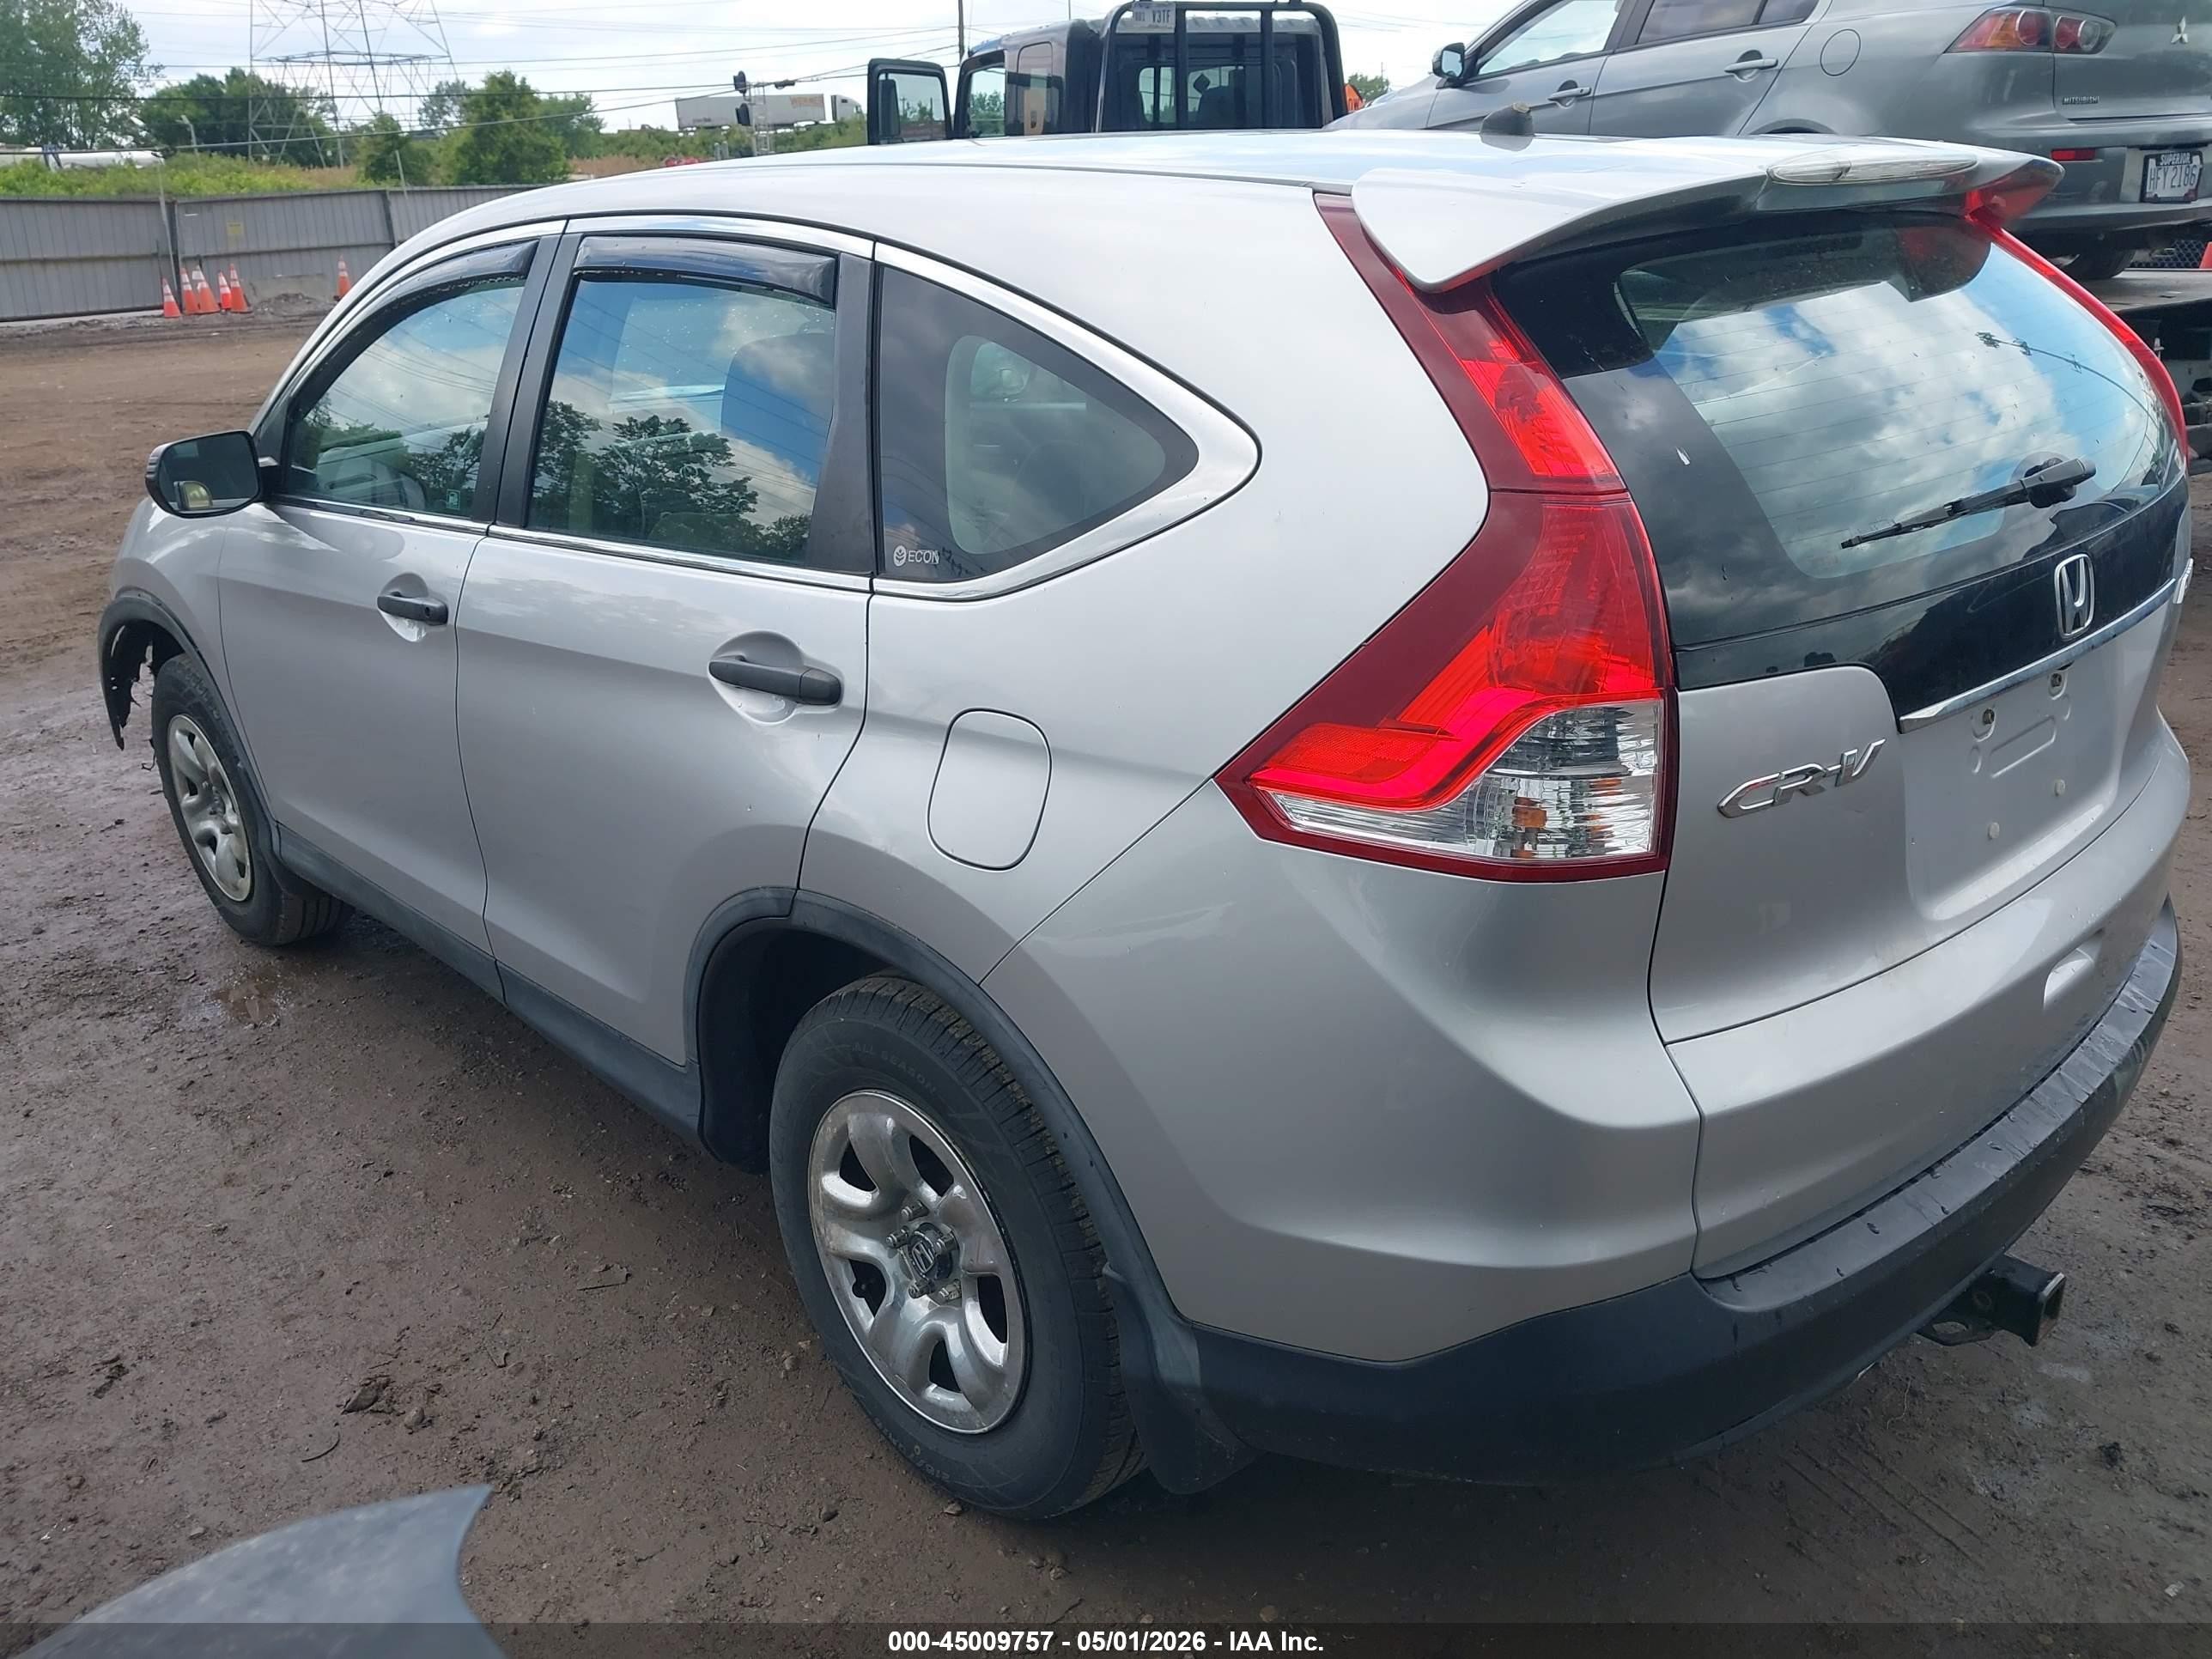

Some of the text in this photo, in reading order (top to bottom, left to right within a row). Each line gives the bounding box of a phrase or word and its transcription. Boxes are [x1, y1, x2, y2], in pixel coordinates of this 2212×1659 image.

[2063, 95, 2100, 105] MITSUBISHI
[2160, 152, 2191, 166] SUPERIOR
[2148, 165, 2197, 191] HFY 2186
[908, 550, 939, 564] ECON
[1717, 738, 1887, 819] CR-V
